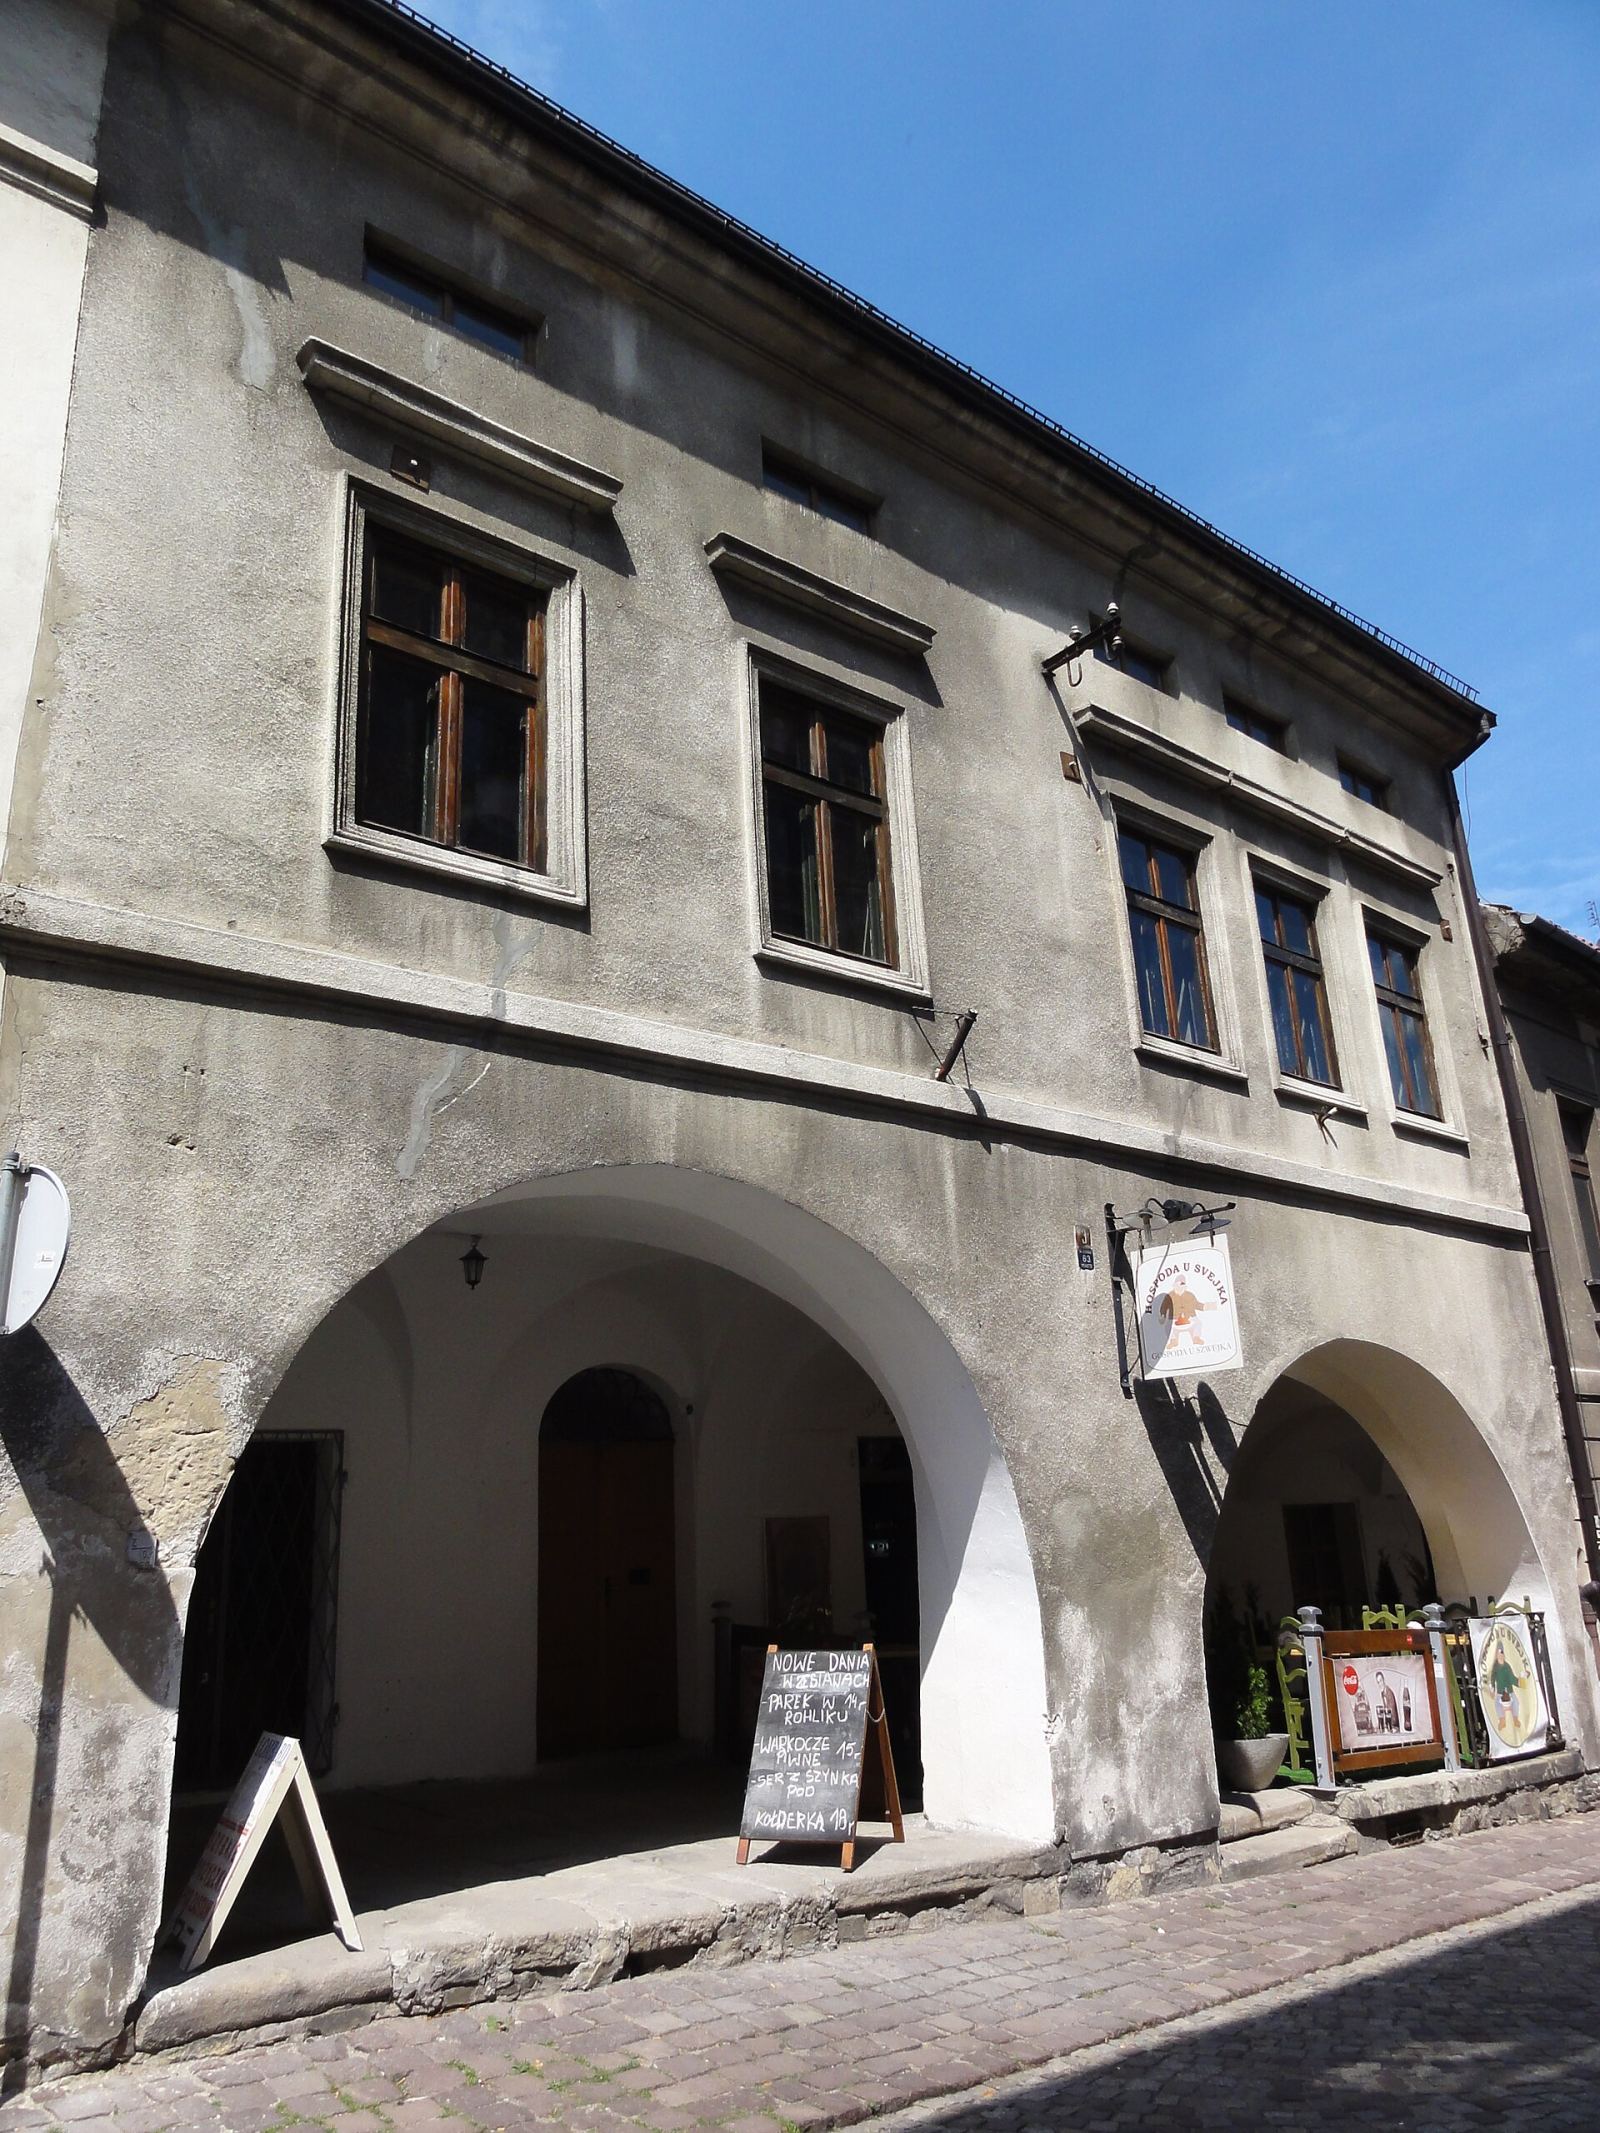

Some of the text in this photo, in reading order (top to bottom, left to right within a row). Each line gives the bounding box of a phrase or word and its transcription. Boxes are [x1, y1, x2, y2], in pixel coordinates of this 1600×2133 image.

[1145, 1263, 1228, 1314] HOSPODA U SVEJKA
[773, 1653, 870, 1672] NOWE DANIA
[822, 1695, 835, 1710] W
[785, 1709, 848, 1726] ROHLIKU
[776, 1748, 821, 1767] PIWNE
[787, 1772, 801, 1782] Z
